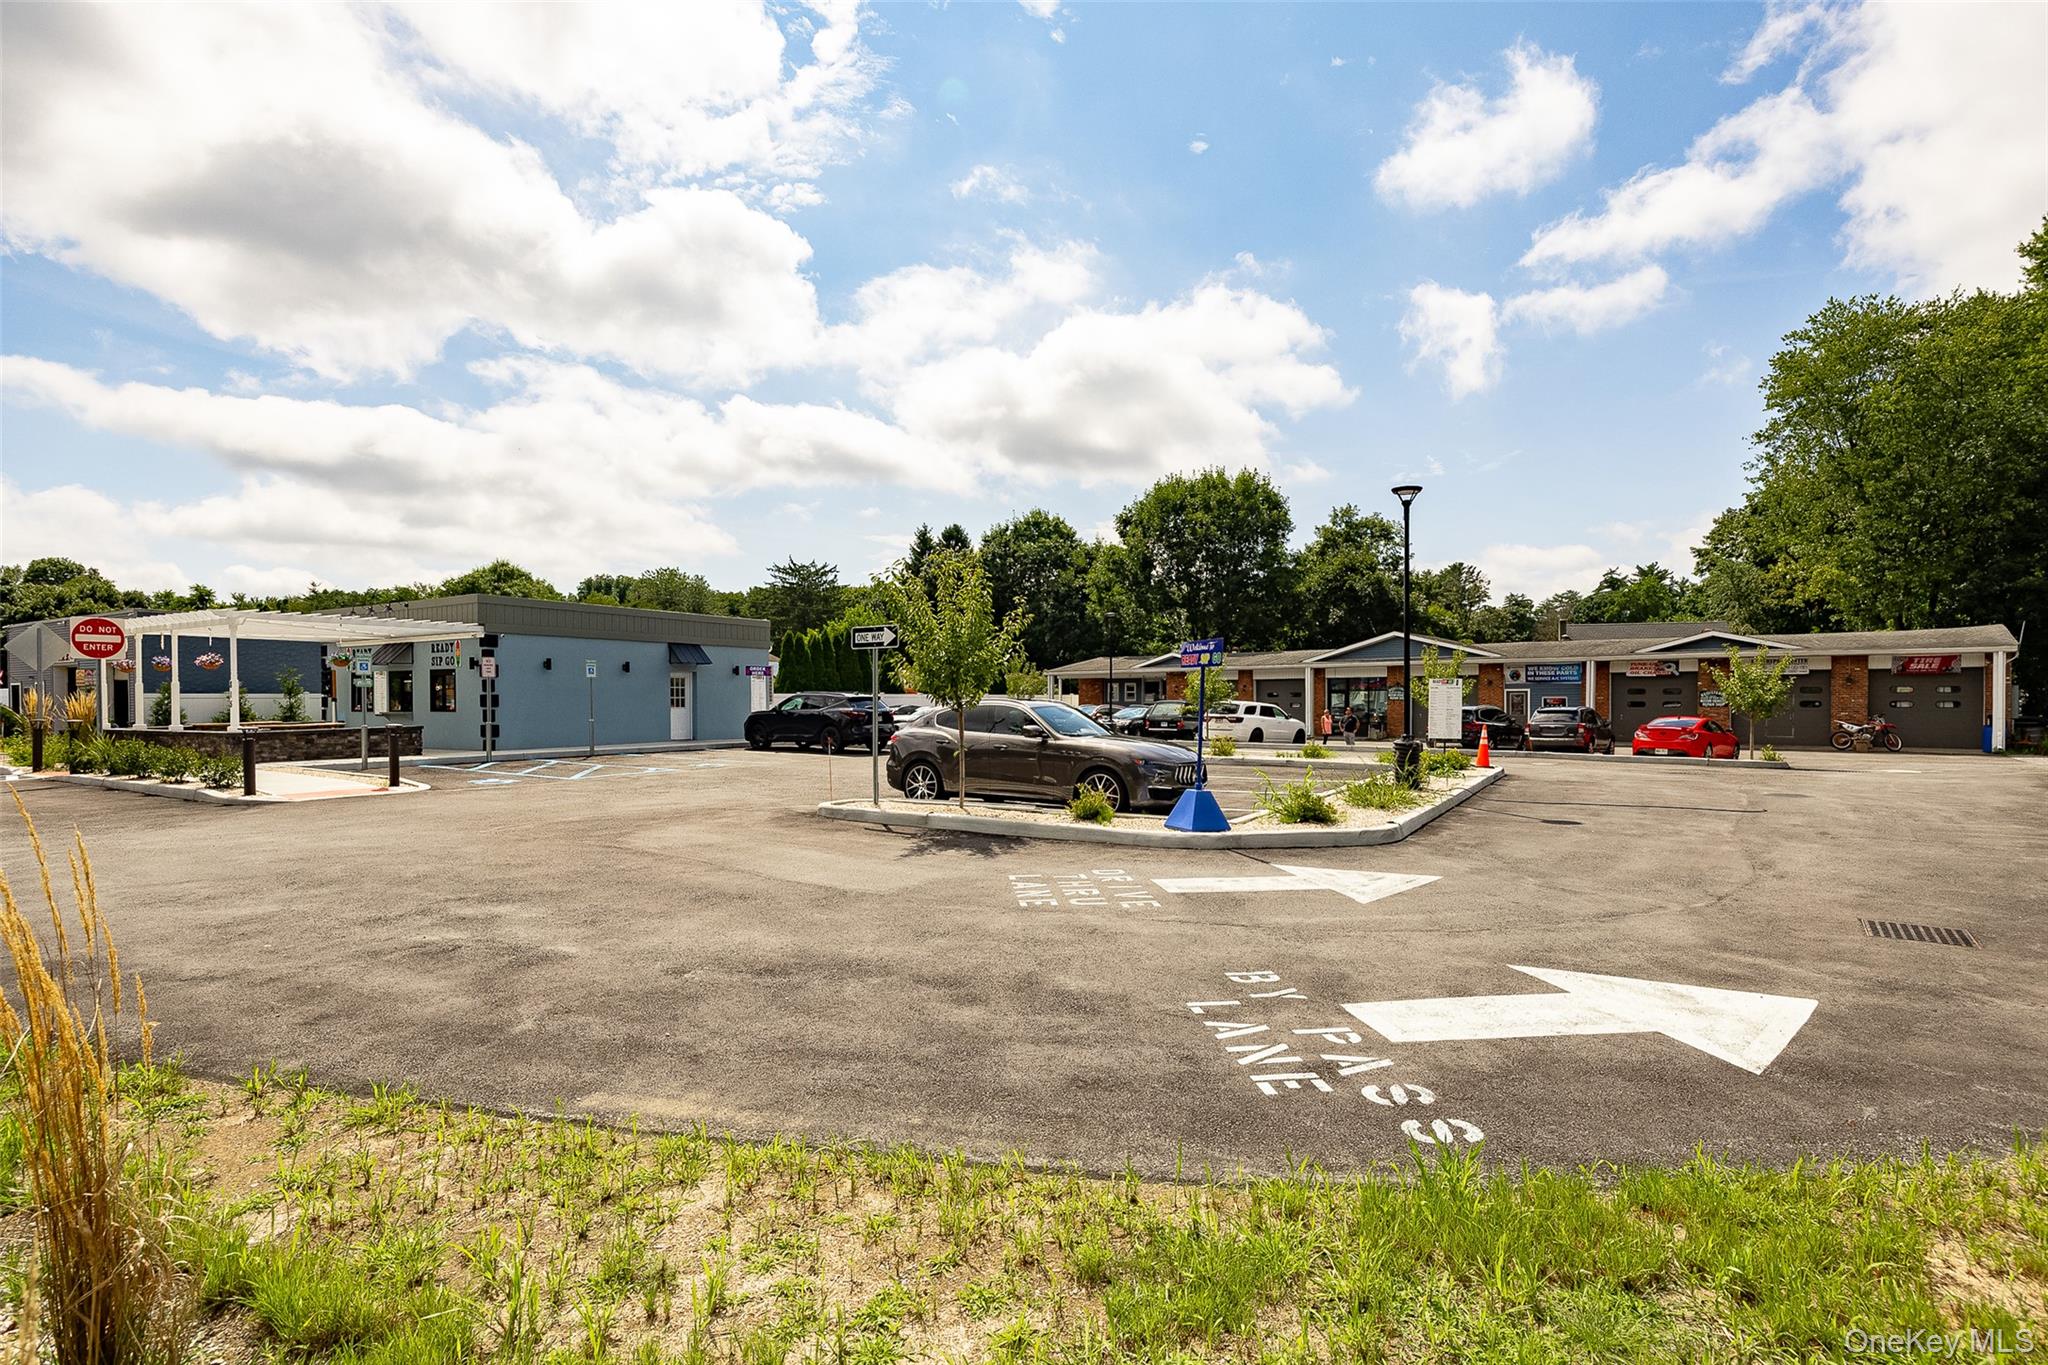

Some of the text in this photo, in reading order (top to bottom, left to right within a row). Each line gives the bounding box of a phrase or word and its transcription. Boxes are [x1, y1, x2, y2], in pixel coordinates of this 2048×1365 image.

[80, 625, 117, 634] DO NOT
[856, 632, 885, 642] ONE WAY
[83, 643, 114, 651] ENTER
[431, 642, 455, 653] READY
[431, 656, 455, 666] SIP GO
[1181, 653, 1199, 666] READY
[1211, 651, 1222, 664] GO
[1008, 874, 1059, 907] LANE
[1053, 873, 1109, 906] THRU
[1091, 869, 1162, 908] DRIVE
[1186, 1000, 1334, 1096] LANE
[1224, 970, 1485, 1144] BY PASS
